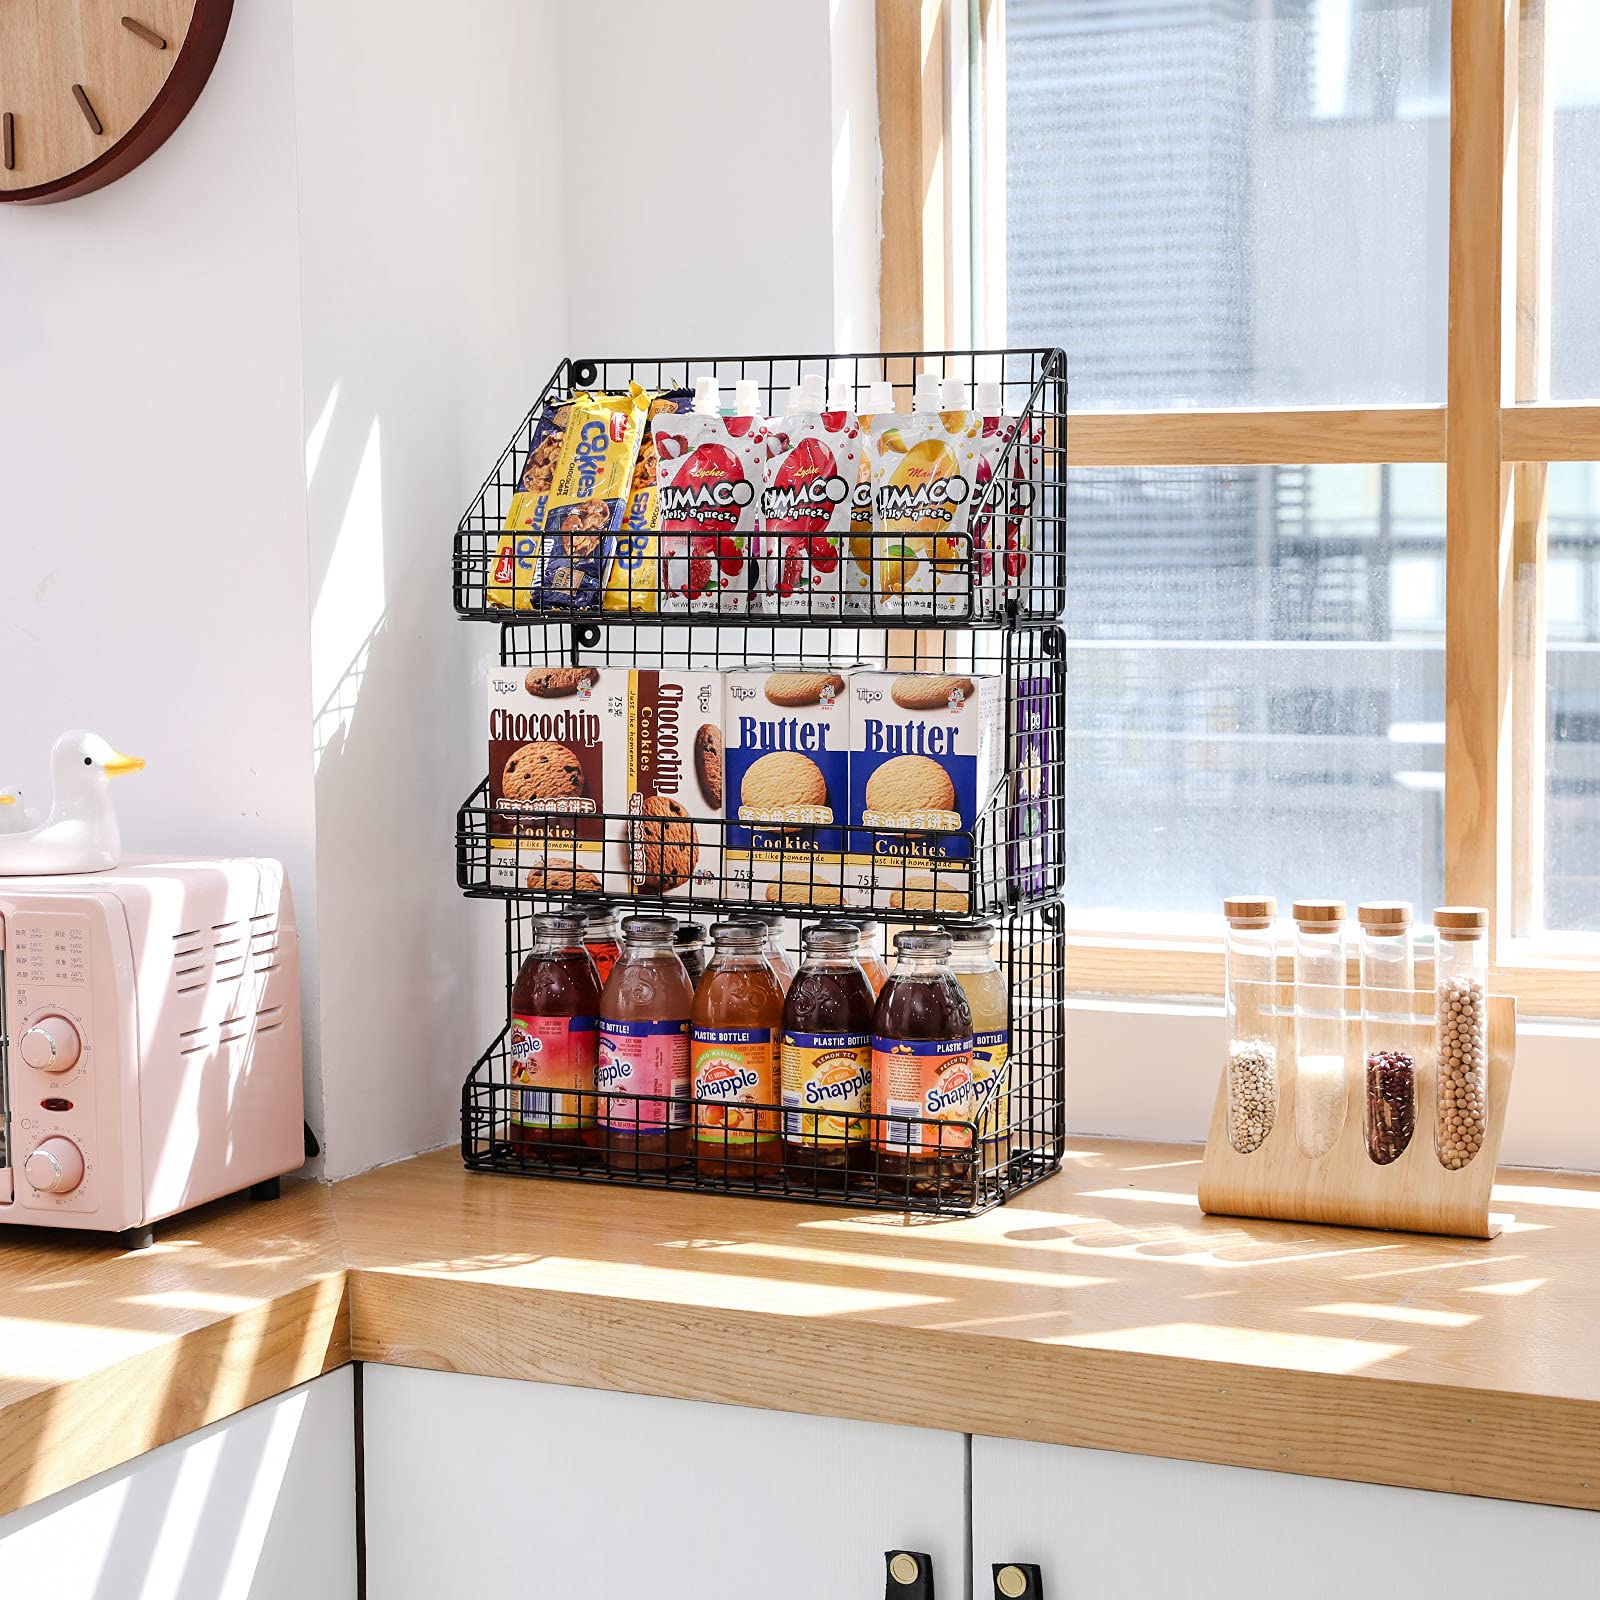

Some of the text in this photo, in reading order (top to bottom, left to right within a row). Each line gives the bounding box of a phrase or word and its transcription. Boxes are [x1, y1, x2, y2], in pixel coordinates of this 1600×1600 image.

[575, 421, 609, 498] Cookies
[564, 462, 576, 496] CHOCOLATE
[692, 466, 728, 479] Lychee
[663, 508, 737, 524] Jelly Squeeze
[788, 507, 830, 520] Squeeze
[904, 507, 951, 522] Squeeze
[493, 680, 518, 695] Tipo
[730, 686, 756, 701] Tipo
[697, 685, 712, 713] Tipo
[856, 689, 883, 703] Tipo
[489, 708, 601, 747] Chocochip
[629, 690, 637, 777] Just like homemade
[739, 716, 831, 752] Butter
[640, 706, 653, 772] Cookies
[653, 683, 684, 795] Chocochip
[864, 719, 959, 755] Butter
[526, 840, 540, 848] like
[752, 834, 820, 851] Cookies
[875, 839, 947, 857] Cookies
[606, 1023, 630, 1034] BOTTLE!
[694, 1030, 750, 1042] PLASTIC BOTTLE!
[813, 1037, 845, 1046] PLASTIC
[976, 1034, 1003, 1045] BOTTLE!
[936, 1042, 962, 1053] PLASTIC
[816, 1052, 856, 1065] LEMON TEA
[940, 1057, 958, 1072] PEACH
[695, 1069, 759, 1100] Snapple
[806, 1067, 872, 1104] Snapple
